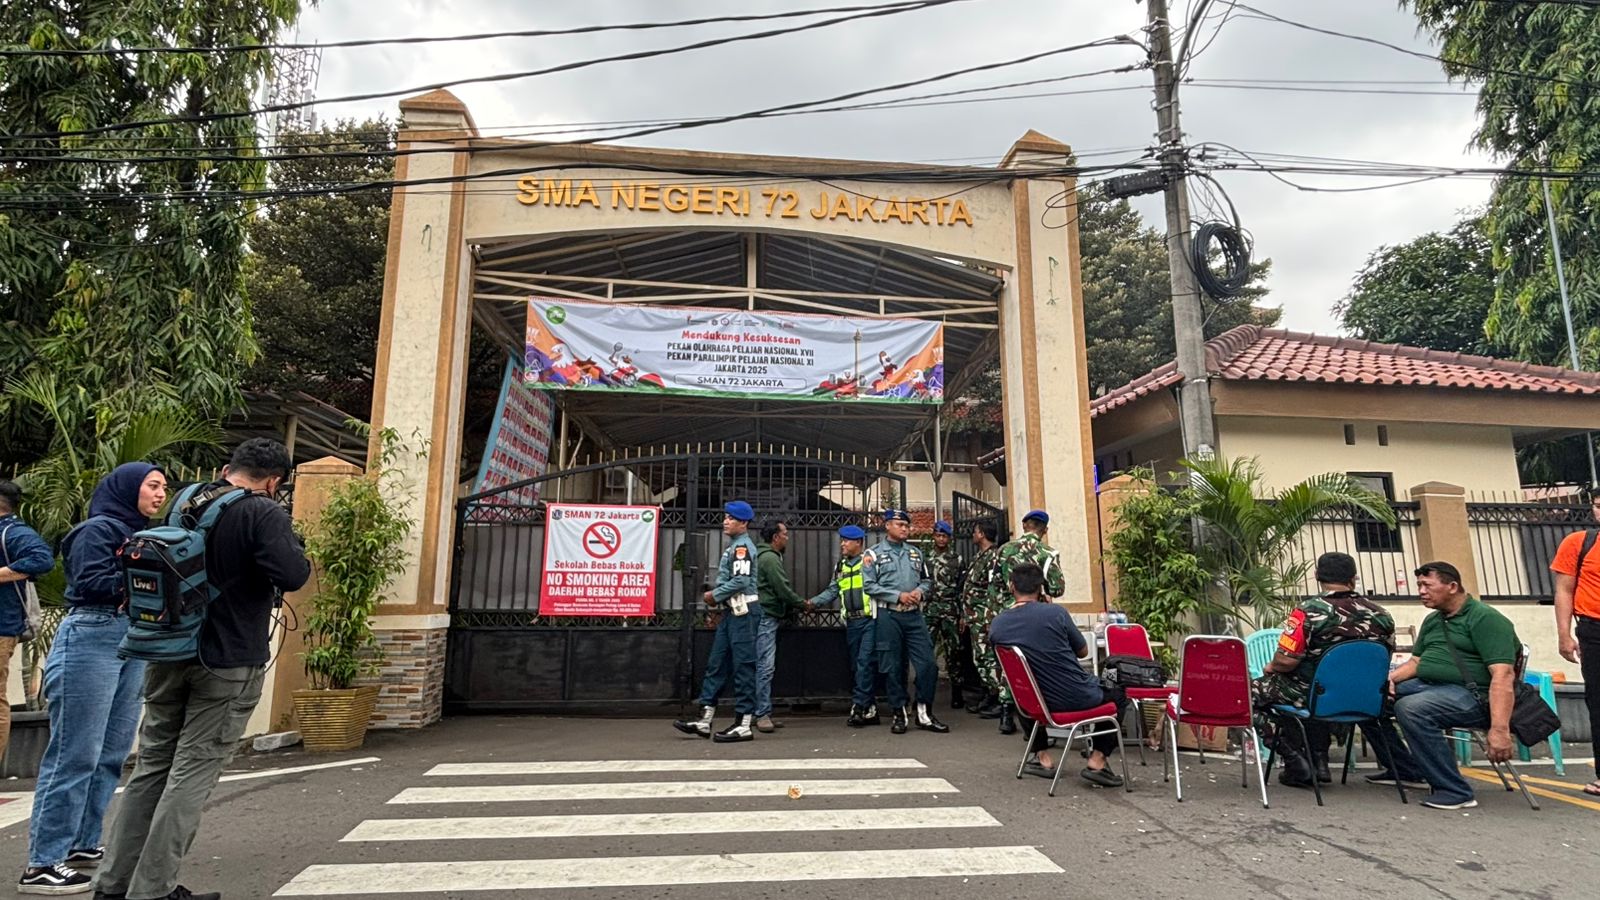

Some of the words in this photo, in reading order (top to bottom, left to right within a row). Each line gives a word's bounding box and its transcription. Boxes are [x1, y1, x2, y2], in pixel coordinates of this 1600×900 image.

[516, 175, 600, 207] SMA
[612, 181, 749, 216] NEGERI
[762, 188, 799, 218] 72
[810, 191, 973, 227] JAKARTA
[682, 330, 740, 342] Mendukung
[744, 333, 801, 345] Kesuksesan
[667, 342, 691, 351] PEKAN
[693, 343, 730, 353] OLAHRAGA
[732, 345, 763, 354] PELAJAR
[764, 346, 798, 356] NASIONAL
[800, 349, 814, 357] XVII
[667, 352, 691, 361] PEKAN
[693, 353, 737, 363] PARALIMPIK
[738, 355, 769, 365] PELAJAR
[770, 356, 804, 366] NASIONAL
[806, 358, 814, 366] XI
[714, 364, 746, 374] JAKARTA
[747, 366, 767, 374] 2025
[697, 376, 726, 385] SMAN
[728, 377, 739, 385] 72
[741, 378, 784, 387] JAKARTA
[564, 510, 591, 519] SMAN
[595, 511, 606, 519] 72
[608, 511, 640, 520] Jakarta
[555, 560, 588, 569] Sekolah
[591, 561, 617, 569] Bebas
[620, 561, 645, 570] Rokok
[733, 560, 751, 576] PM
[546, 573, 563, 585] NO
[566, 573, 618, 586] SMOKING
[621, 574, 650, 587] AREA
[549, 586, 584, 596] DAERAH
[587, 587, 615, 596] BEBAS
[618, 587, 647, 597] ROKOK
